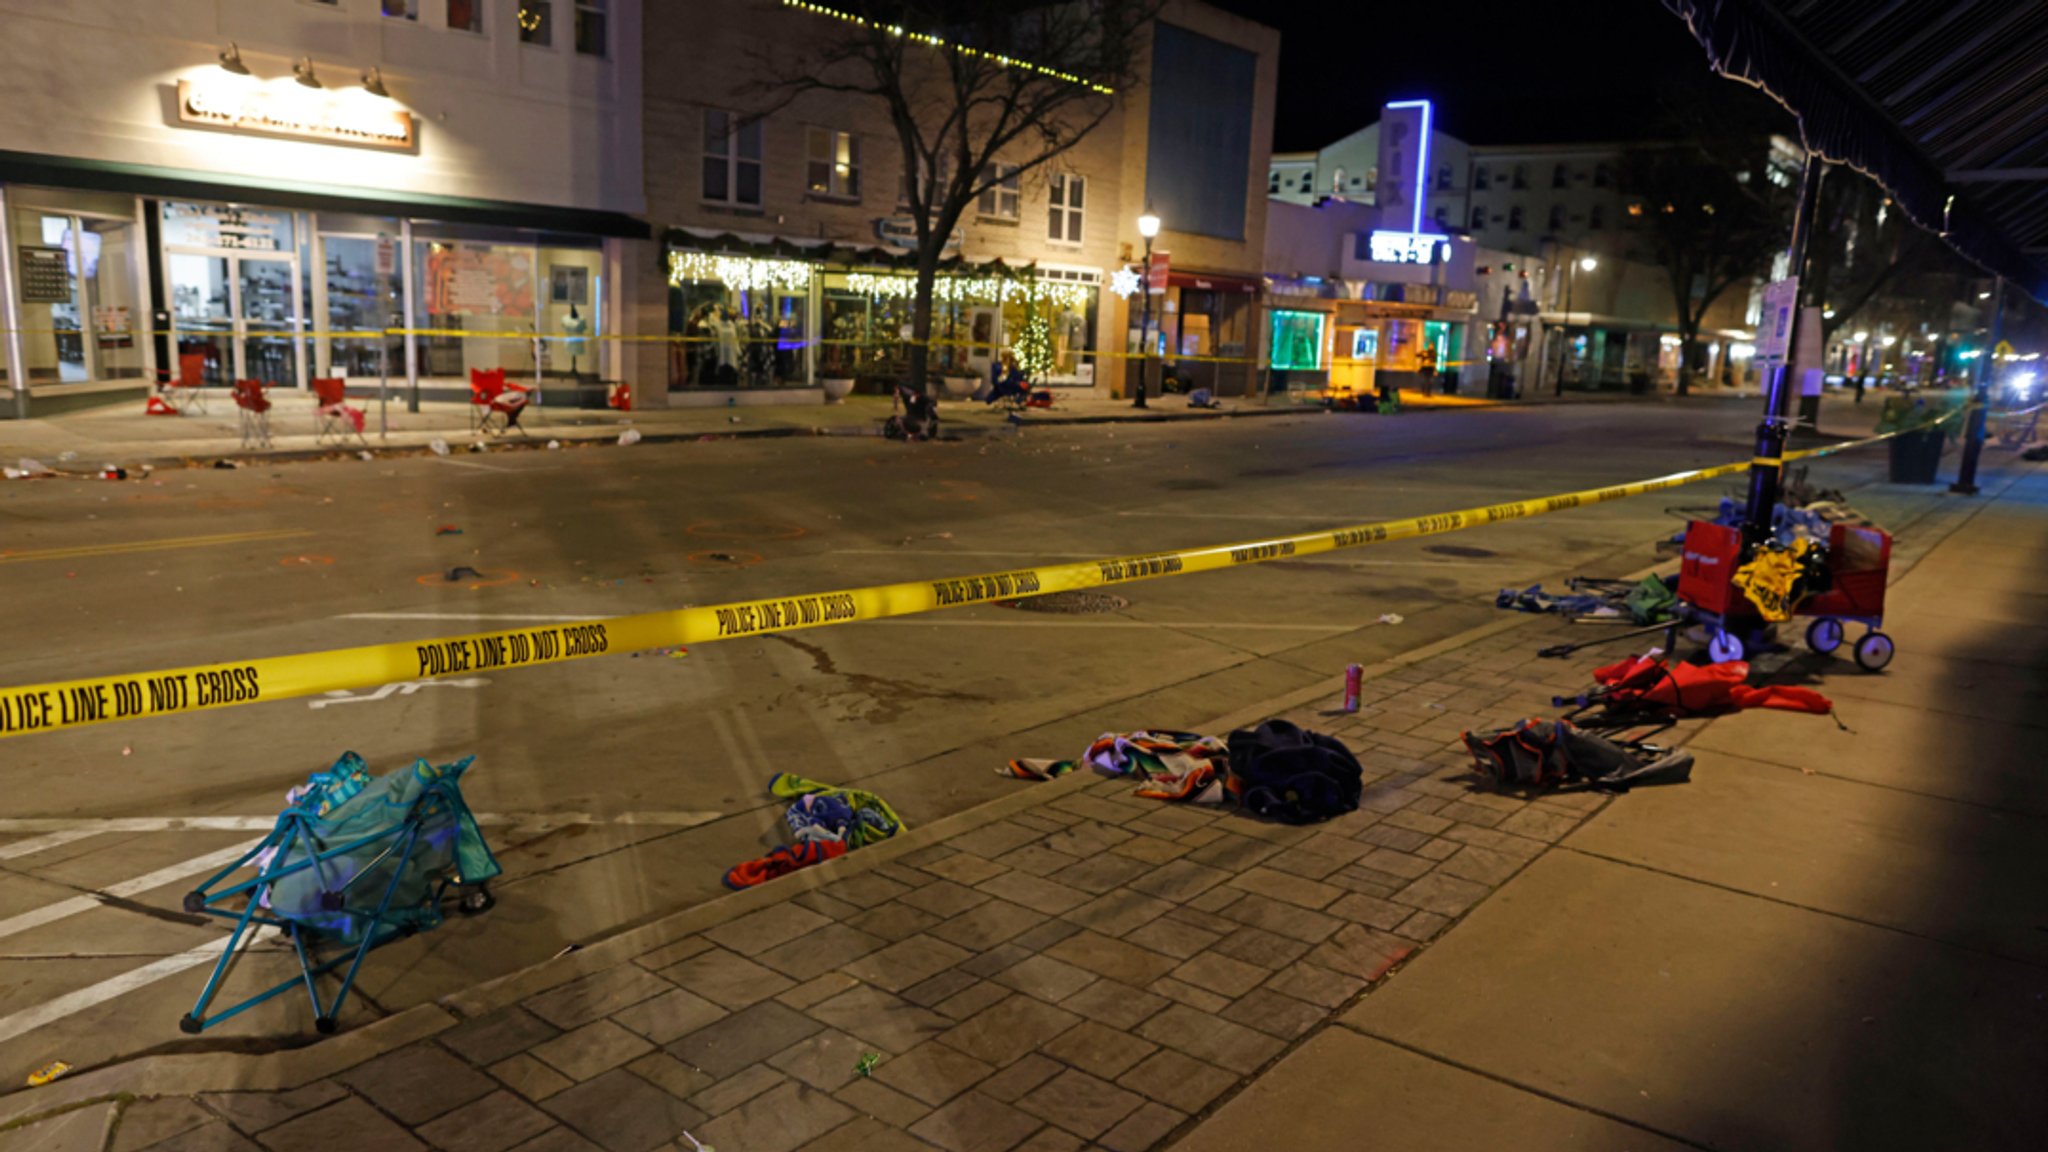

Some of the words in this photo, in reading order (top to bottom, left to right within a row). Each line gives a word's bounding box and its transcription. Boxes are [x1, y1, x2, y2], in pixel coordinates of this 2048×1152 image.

[1385, 122, 1409, 206] PIX
[715, 606, 755, 635] POLICE
[757, 603, 781, 630] LINE
[782, 601, 798, 626] DO
[798, 598, 820, 624] NOT
[821, 594, 856, 621] CROSS
[417, 641, 470, 676] POLICE
[472, 636, 507, 669] LINE
[509, 634, 530, 664] DO
[531, 630, 560, 660] NOT
[562, 624, 608, 657] CROSS
[58, 684, 108, 725] LINE
[113, 680, 142, 717] DO
[147, 675, 189, 712] NOT
[195, 666, 260, 706] CROSS
